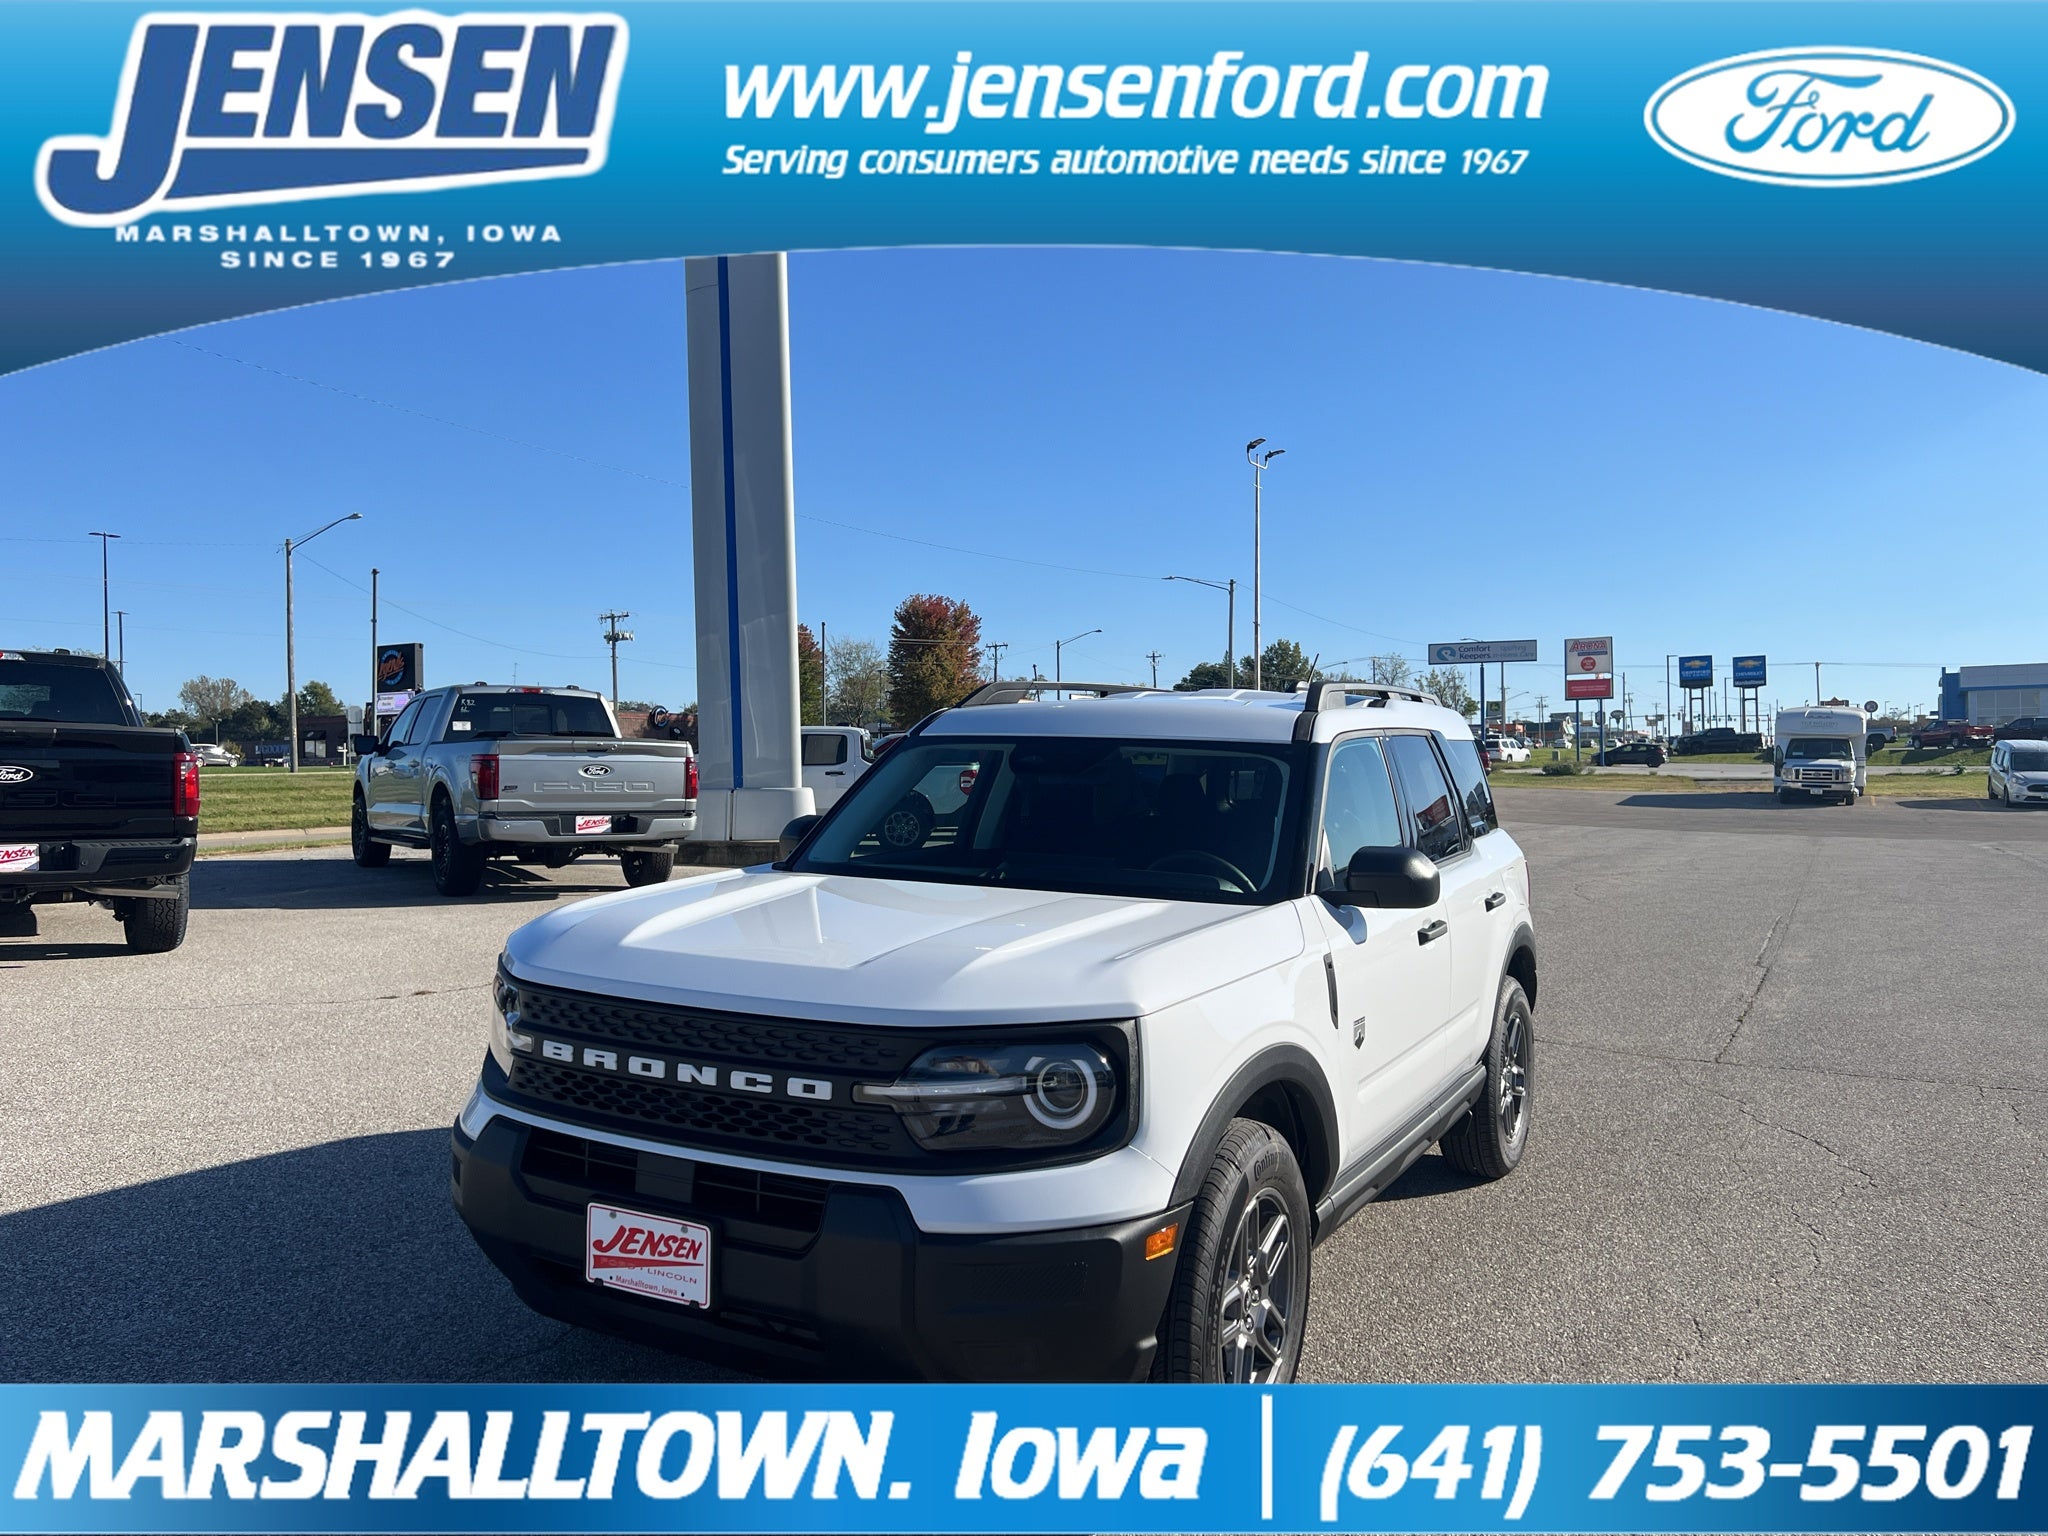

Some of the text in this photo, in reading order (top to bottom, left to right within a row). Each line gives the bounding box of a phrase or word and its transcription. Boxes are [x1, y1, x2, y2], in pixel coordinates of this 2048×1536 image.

[1458, 645, 1491, 653] Comfort
[1568, 639, 1607, 652] ARONA
[1459, 652, 1491, 660] Keepers
[533, 781, 655, 793] F-150
[578, 816, 610, 828] JENSEN
[542, 1039, 833, 1101] BRONCO
[592, 1224, 703, 1261] JENSEN
[647, 1267, 698, 1285] LINCOLN
[615, 1275, 678, 1296] Marshalltown, Iowa
